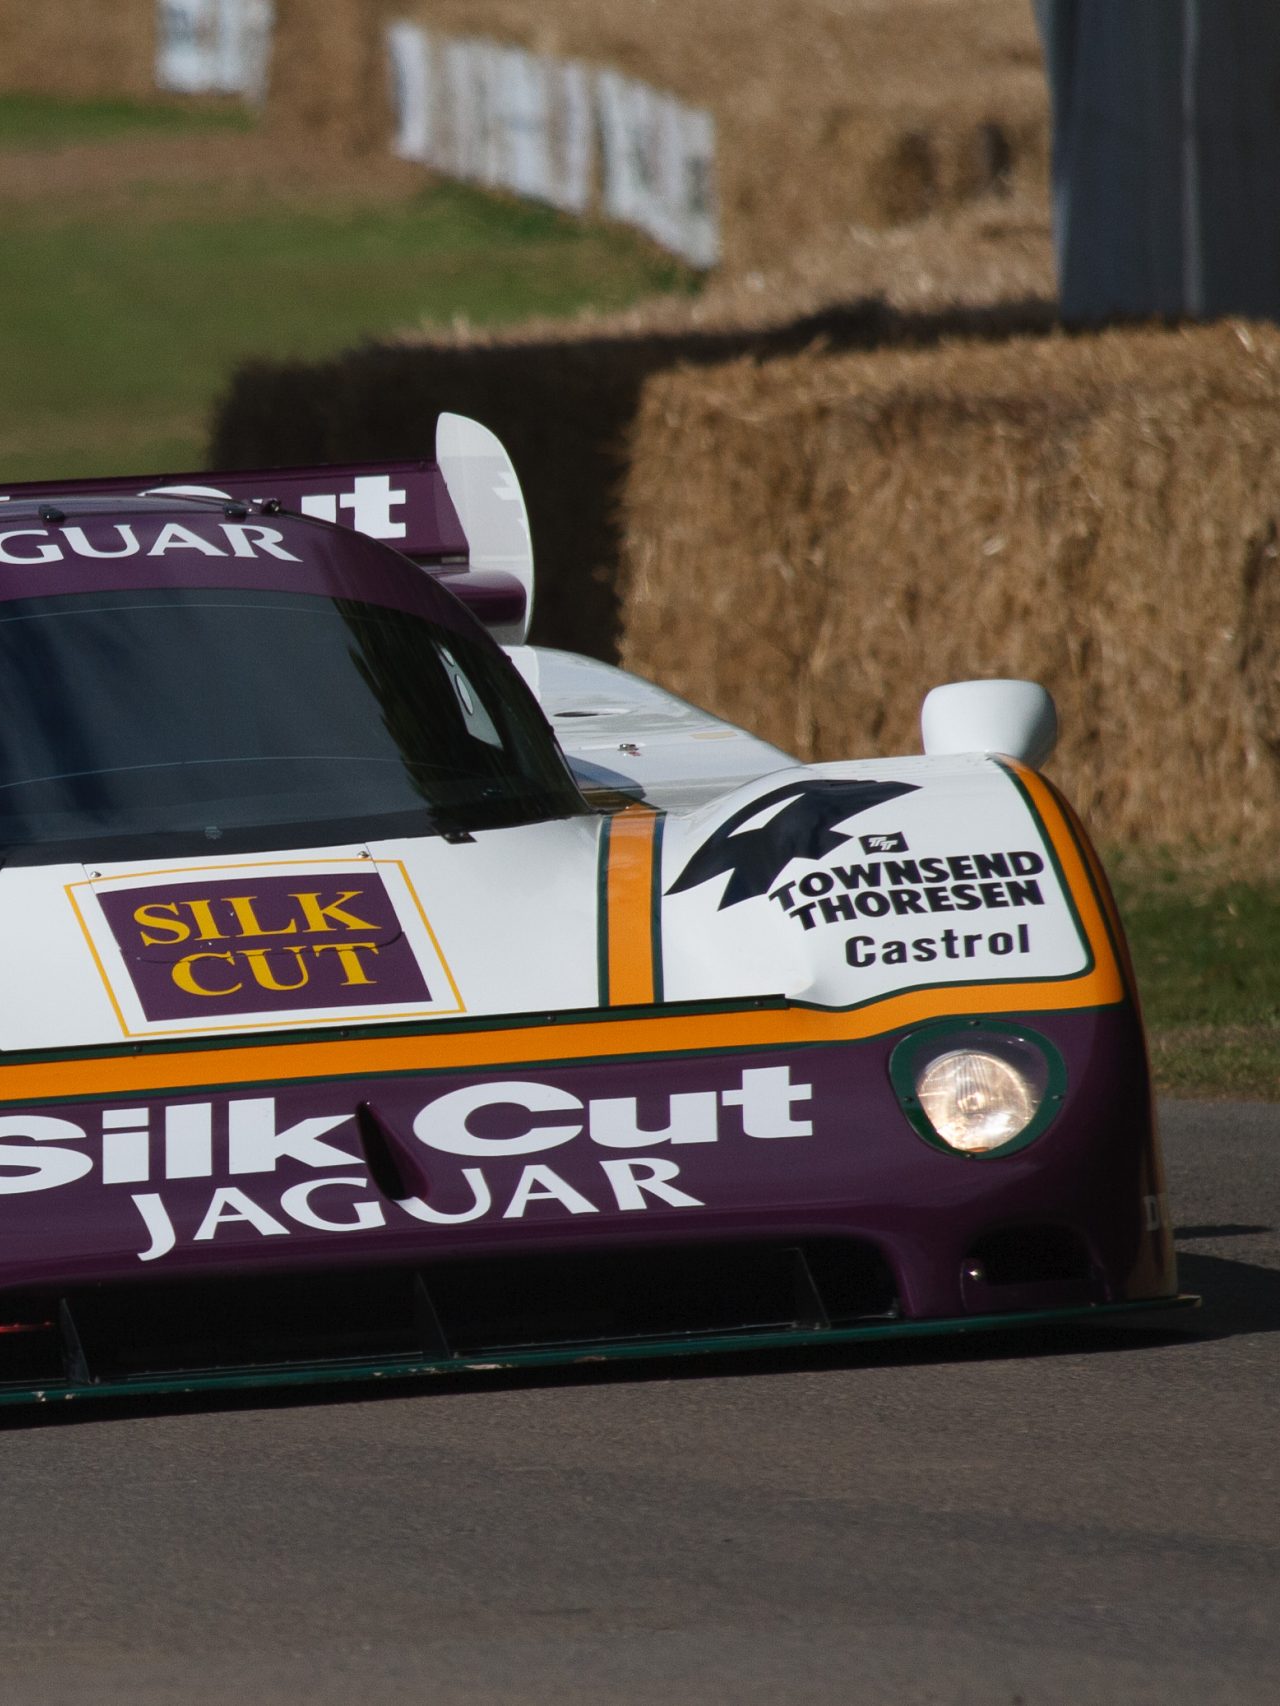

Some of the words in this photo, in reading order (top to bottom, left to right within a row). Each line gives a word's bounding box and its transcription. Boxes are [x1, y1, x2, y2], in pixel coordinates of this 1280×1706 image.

[769, 850, 1045, 913] TOWNSEND
[789, 879, 1046, 931] THORESEN
[133, 890, 384, 948] SILK
[845, 923, 1031, 968] Castrol
[171, 940, 380, 998] CUT
[412, 1065, 813, 1157] Cut
[136, 1156, 705, 1262] JAGUAR
